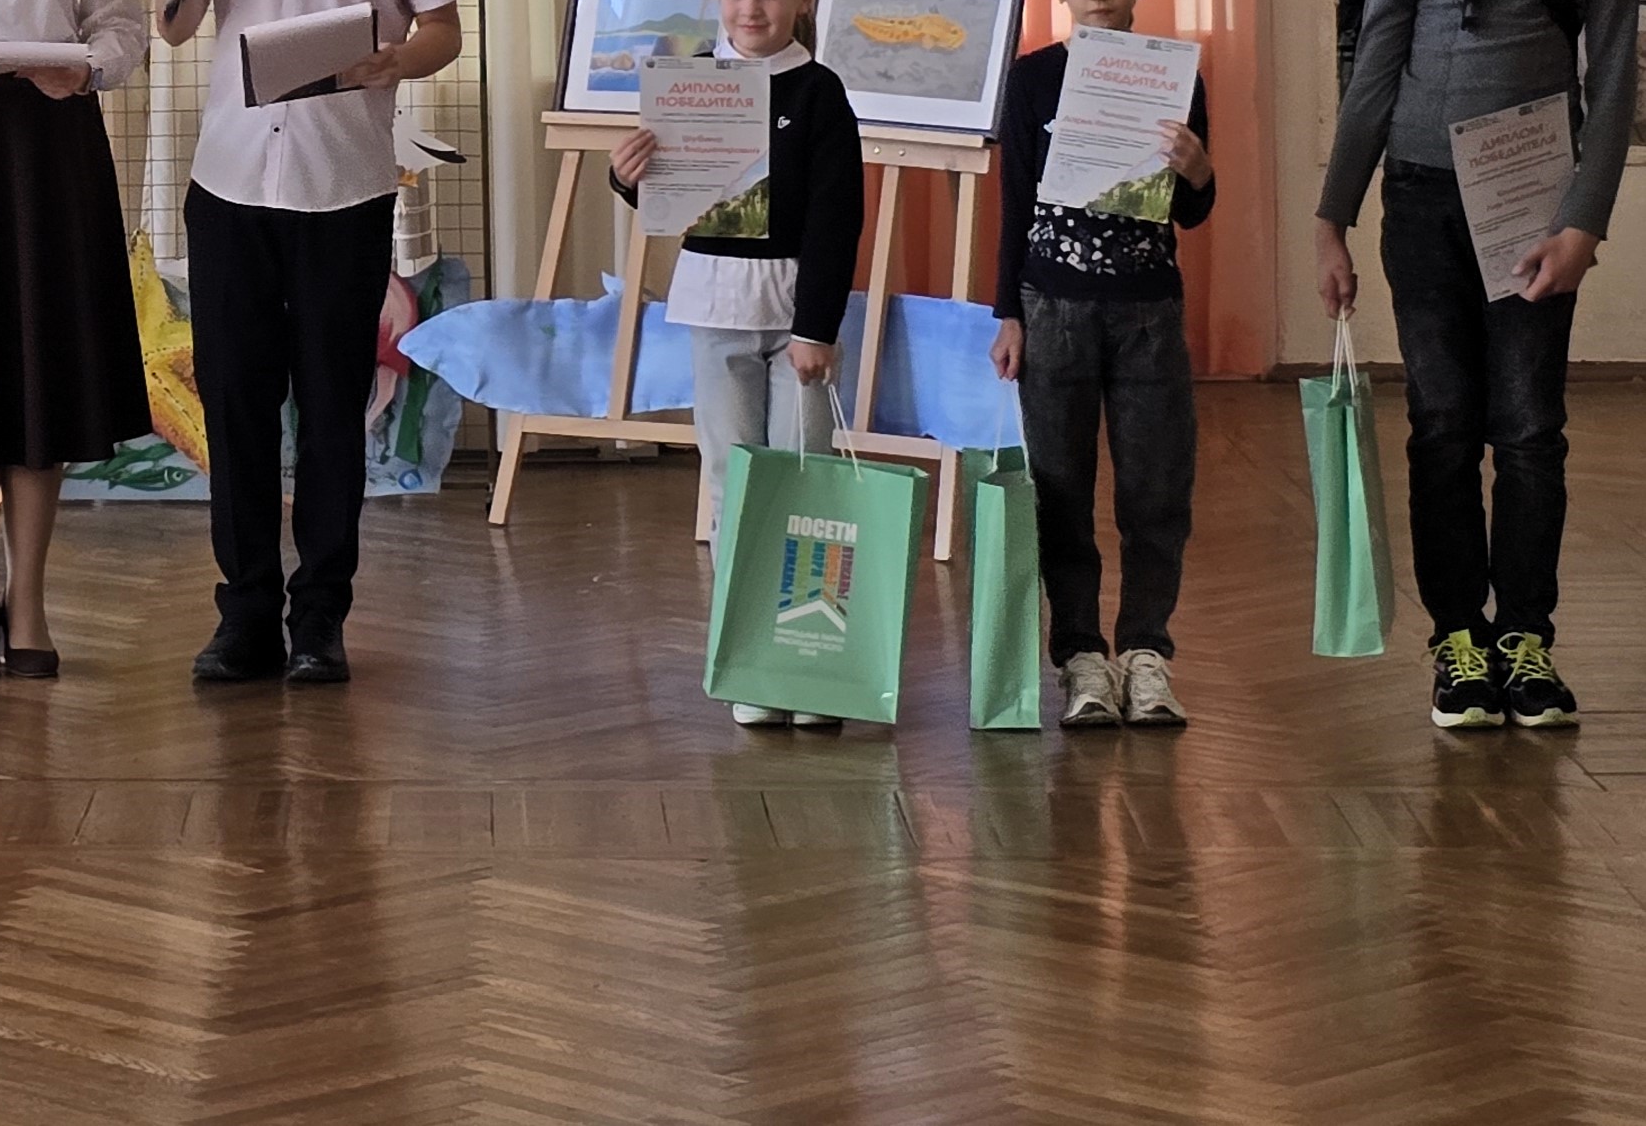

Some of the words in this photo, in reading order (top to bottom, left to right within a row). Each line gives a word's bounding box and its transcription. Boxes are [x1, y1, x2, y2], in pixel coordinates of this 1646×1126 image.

[1095, 56, 1168, 75] ДИПЛОМ
[668, 82, 740, 94] ДИПЛОМ
[1080, 67, 1179, 92] ПОБЕДИТЕЛЯ
[655, 96, 754, 108] ПОБЕДИТЕЛЯ
[1469, 133, 1557, 168] ПОБЕДИТЕЛЯ
[1479, 123, 1545, 153] ДИПЛОМ
[787, 515, 858, 543] ПОСЕТИ
